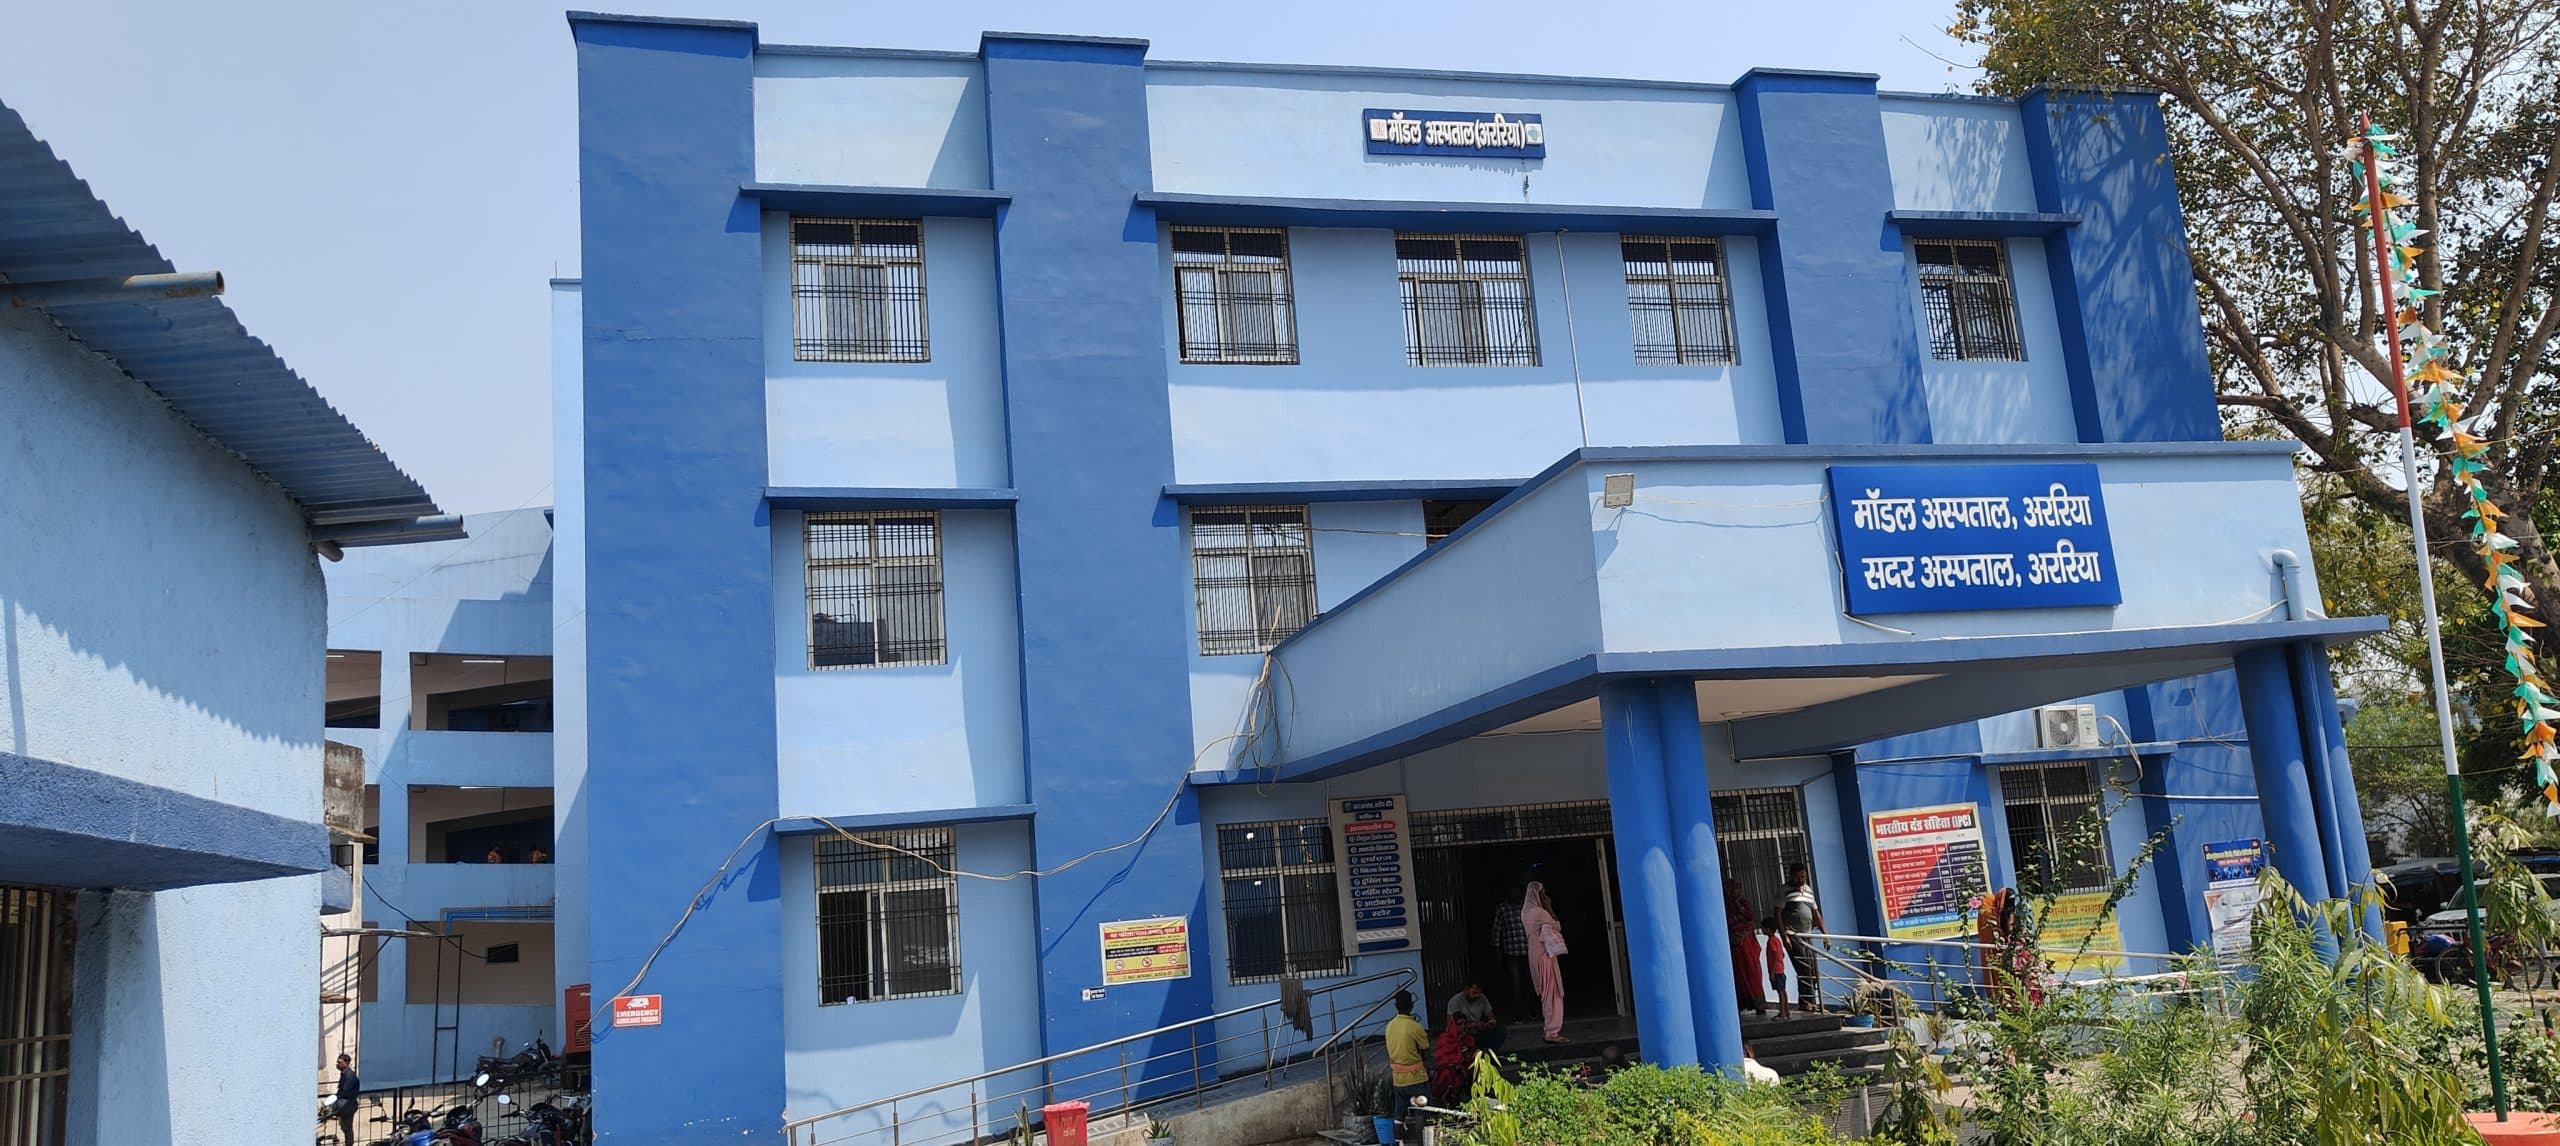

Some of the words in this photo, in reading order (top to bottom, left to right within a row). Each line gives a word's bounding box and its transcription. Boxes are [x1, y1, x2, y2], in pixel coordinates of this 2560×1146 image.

[1387, 112, 1422, 144] मॉडल
[1852, 488, 1916, 533] मॉडल
[1921, 496, 2018, 531] अस्पताल,
[2022, 482, 2093, 527] अररिया
[1862, 556, 1916, 591] सदर
[1921, 553, 2022, 589] अस्पताल,
[2028, 539, 2101, 584] अररिया
[1875, 820, 1908, 835] भारतीय
[1911, 818, 1923, 831] दंड
[1924, 816, 1951, 830] संहिता
[1952, 814, 1971, 828] (IPC)
